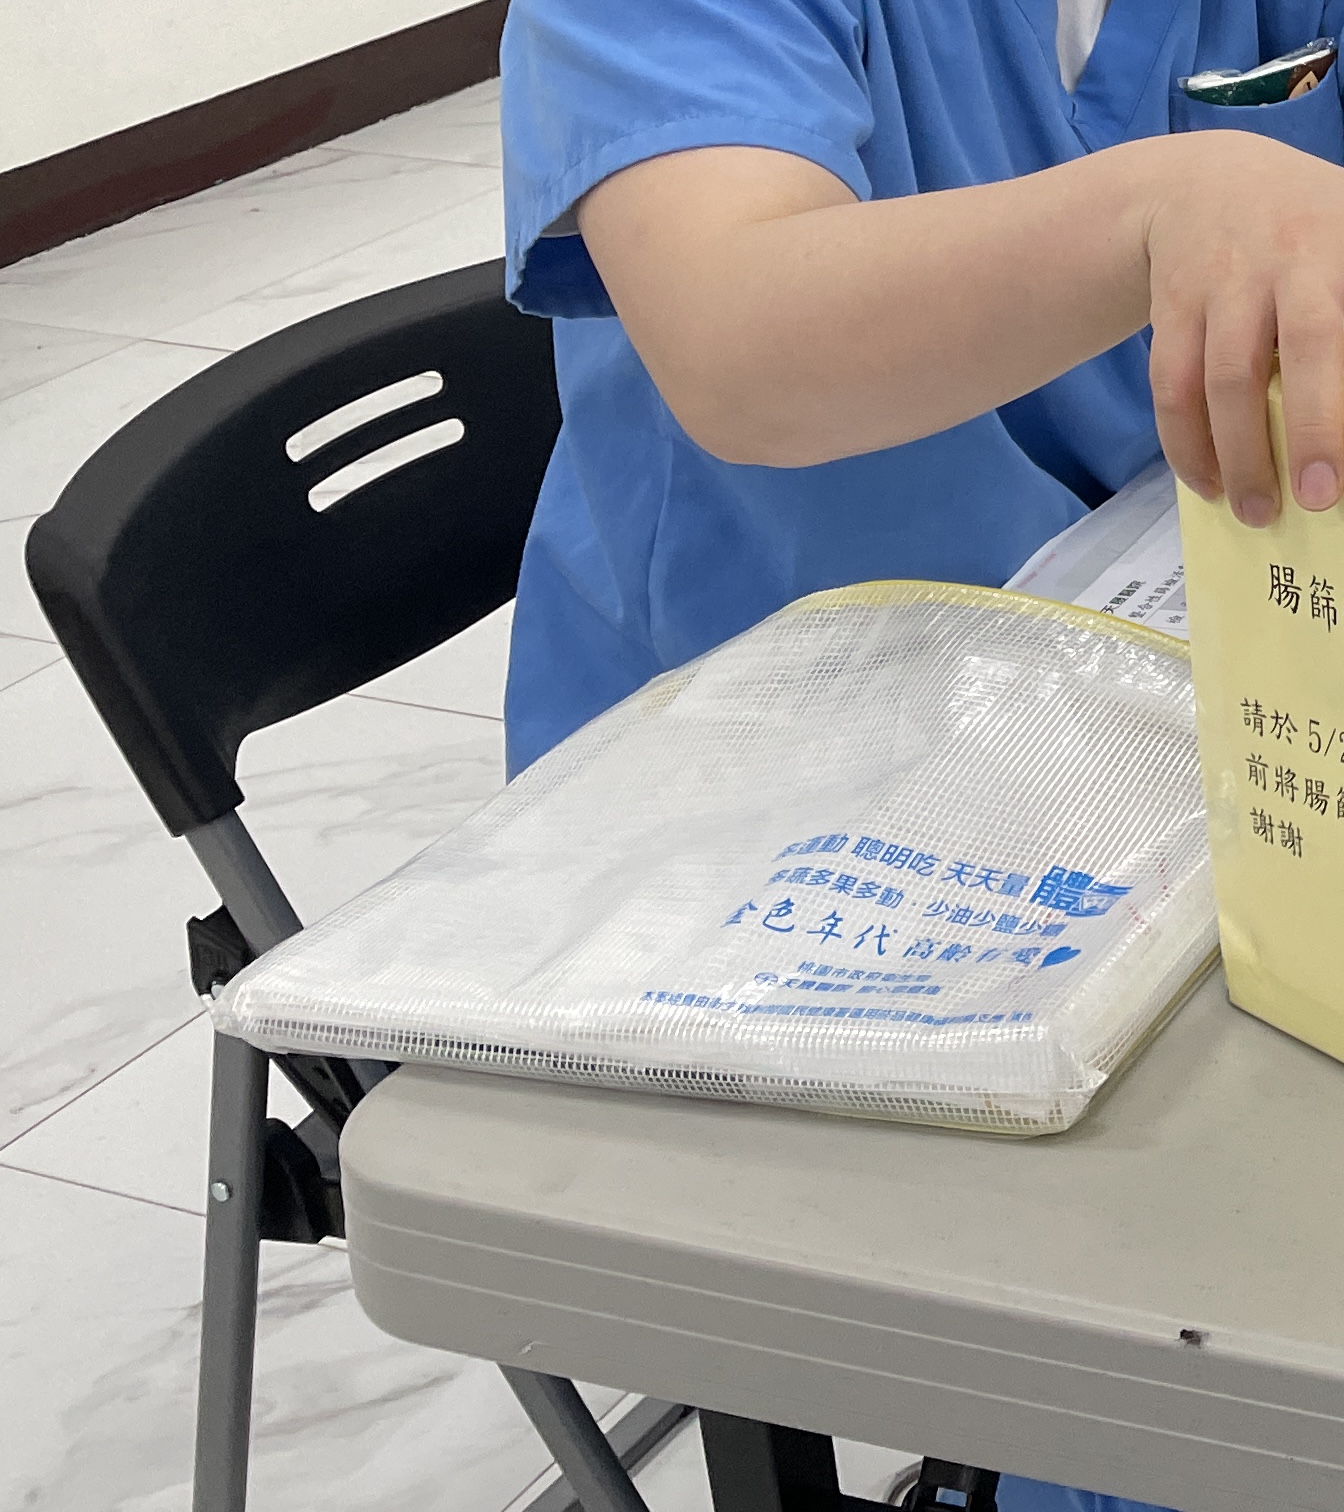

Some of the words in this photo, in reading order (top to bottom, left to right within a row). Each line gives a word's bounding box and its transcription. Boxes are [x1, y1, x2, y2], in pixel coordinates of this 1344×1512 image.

[851, 835, 942, 878] 聰明吃
[1249, 806, 1304, 859] 謝謝
